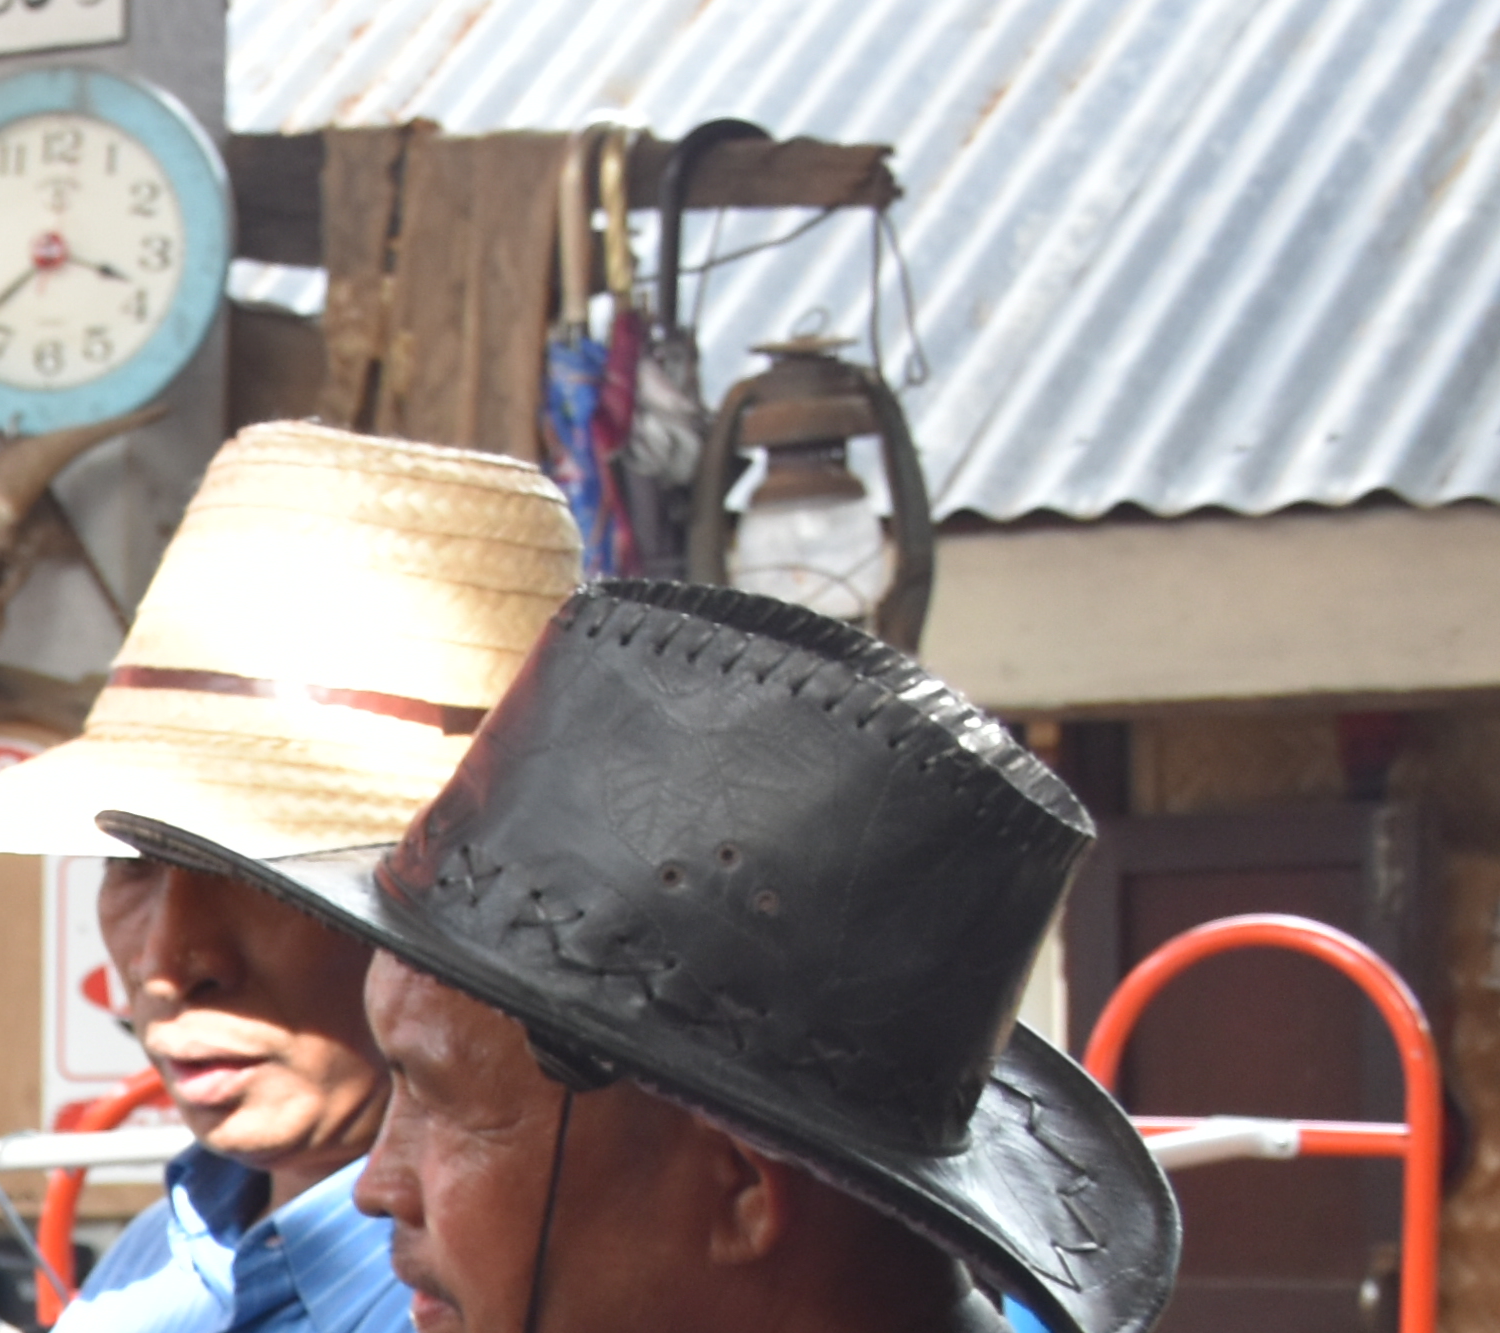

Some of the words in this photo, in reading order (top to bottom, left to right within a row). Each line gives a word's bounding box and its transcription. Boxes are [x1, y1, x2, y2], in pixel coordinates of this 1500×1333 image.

[42, 128, 83, 165] 12
[128, 180, 162, 218] 2
[138, 235, 173, 272] 3
[33, 338, 65, 377] 6
[82, 325, 115, 363] 5
